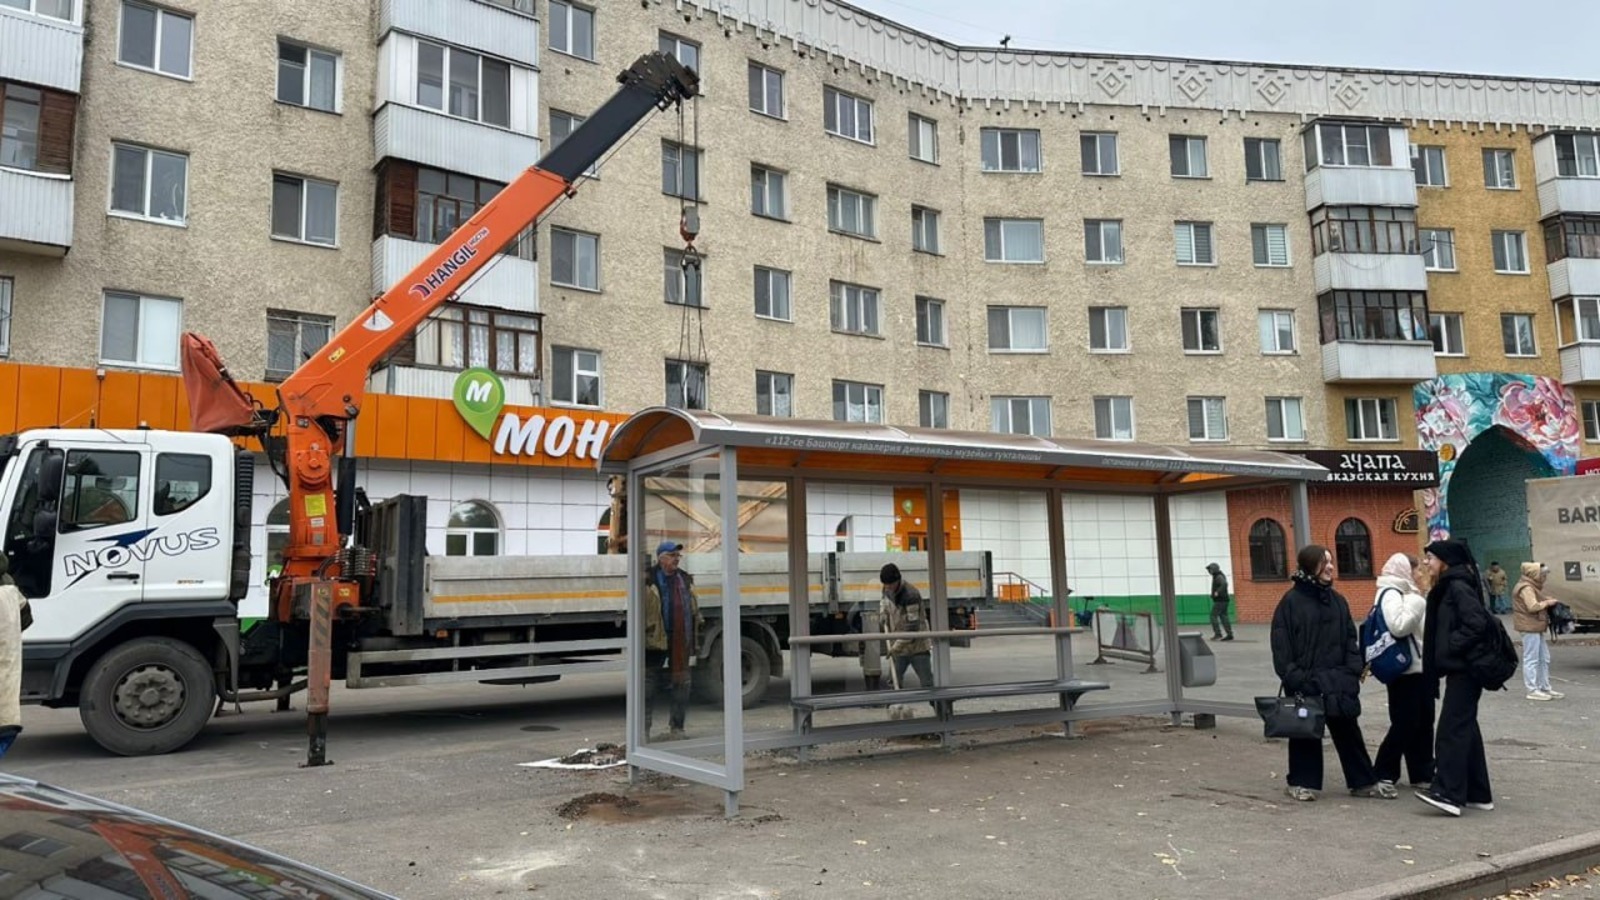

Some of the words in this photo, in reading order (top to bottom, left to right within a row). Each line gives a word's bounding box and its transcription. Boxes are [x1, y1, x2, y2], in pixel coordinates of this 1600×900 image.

[426, 244, 477, 289] HANGIL
[466, 380, 492, 402] М
[494, 412, 623, 459] МОН
[1394, 472, 1434, 481] КУХНЯ
[1558, 505, 1600, 524] BAR
[64, 527, 220, 577] NOVUS
